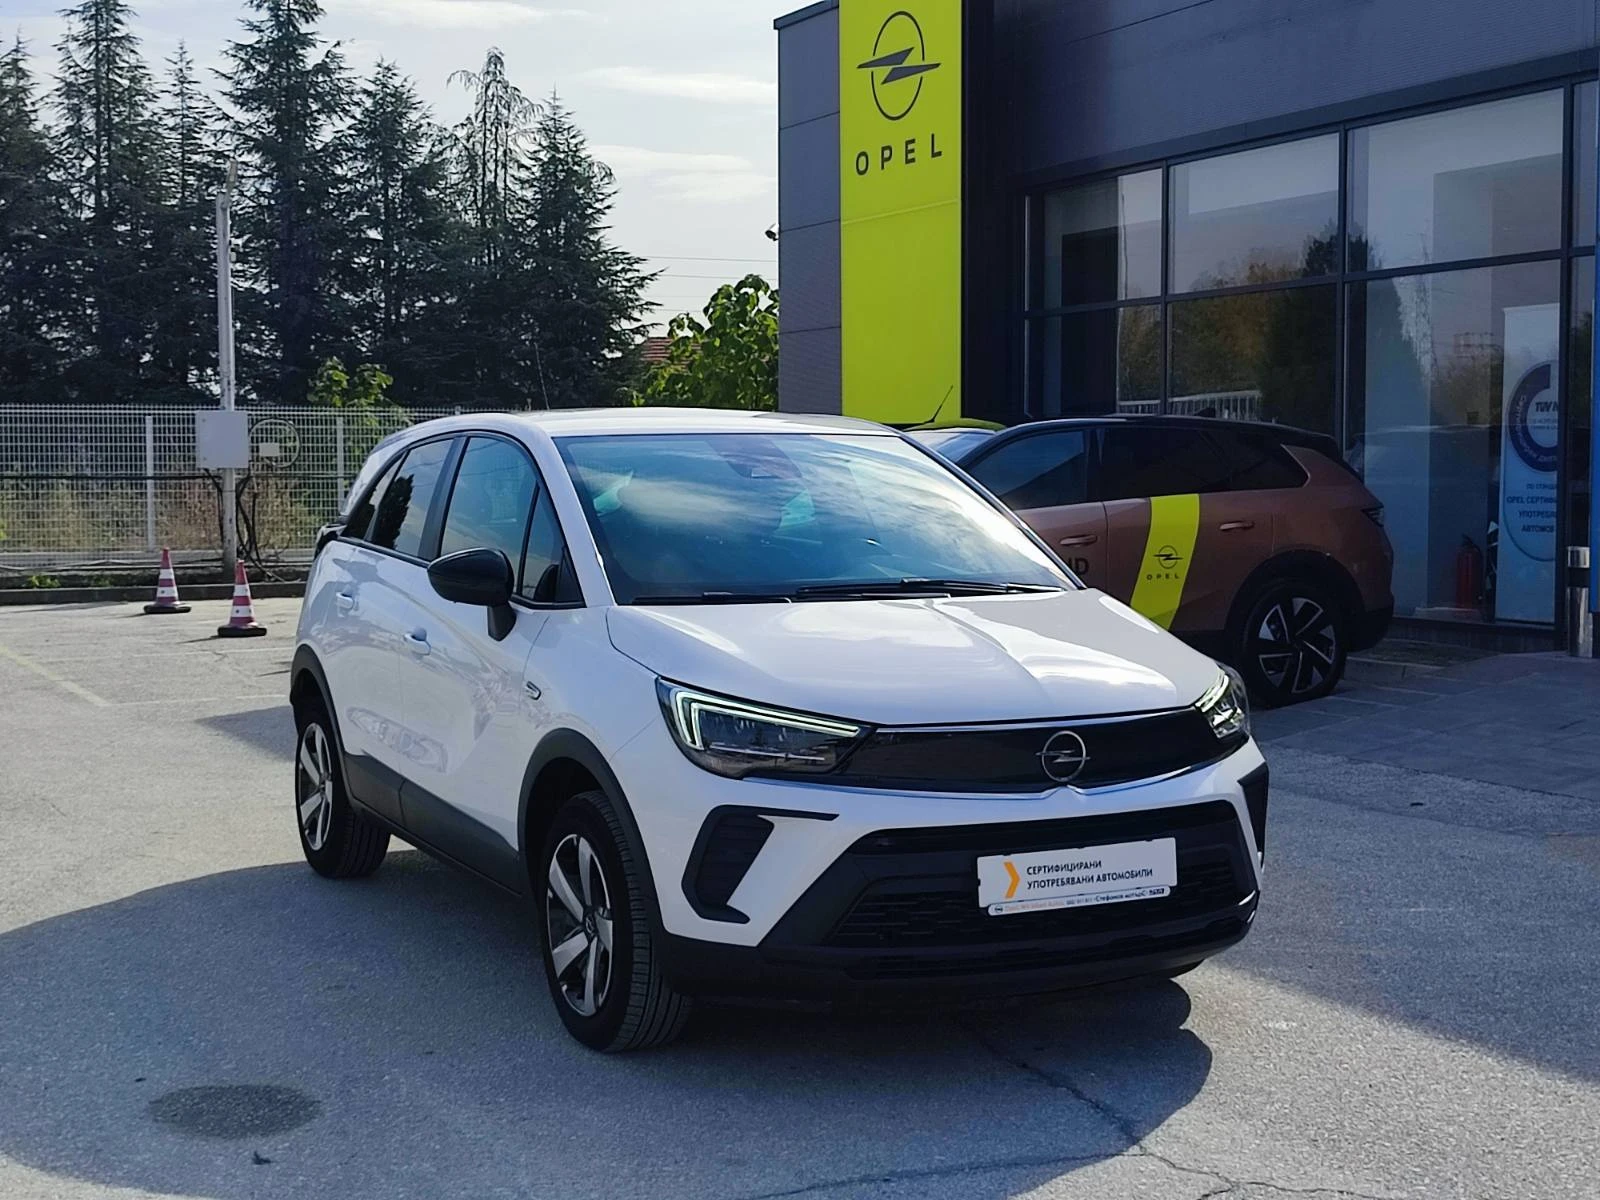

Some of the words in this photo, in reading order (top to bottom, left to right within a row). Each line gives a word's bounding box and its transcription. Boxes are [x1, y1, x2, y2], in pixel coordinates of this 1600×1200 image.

[855, 133, 943, 175] OPEL
[1026, 860, 1102, 876] СЕРТИФИЦИРАНИ
[1027, 875, 1094, 889] УПОТРЕБЯВАНИ
[1095, 868, 1153, 882] АВТОМОБИЛИ
